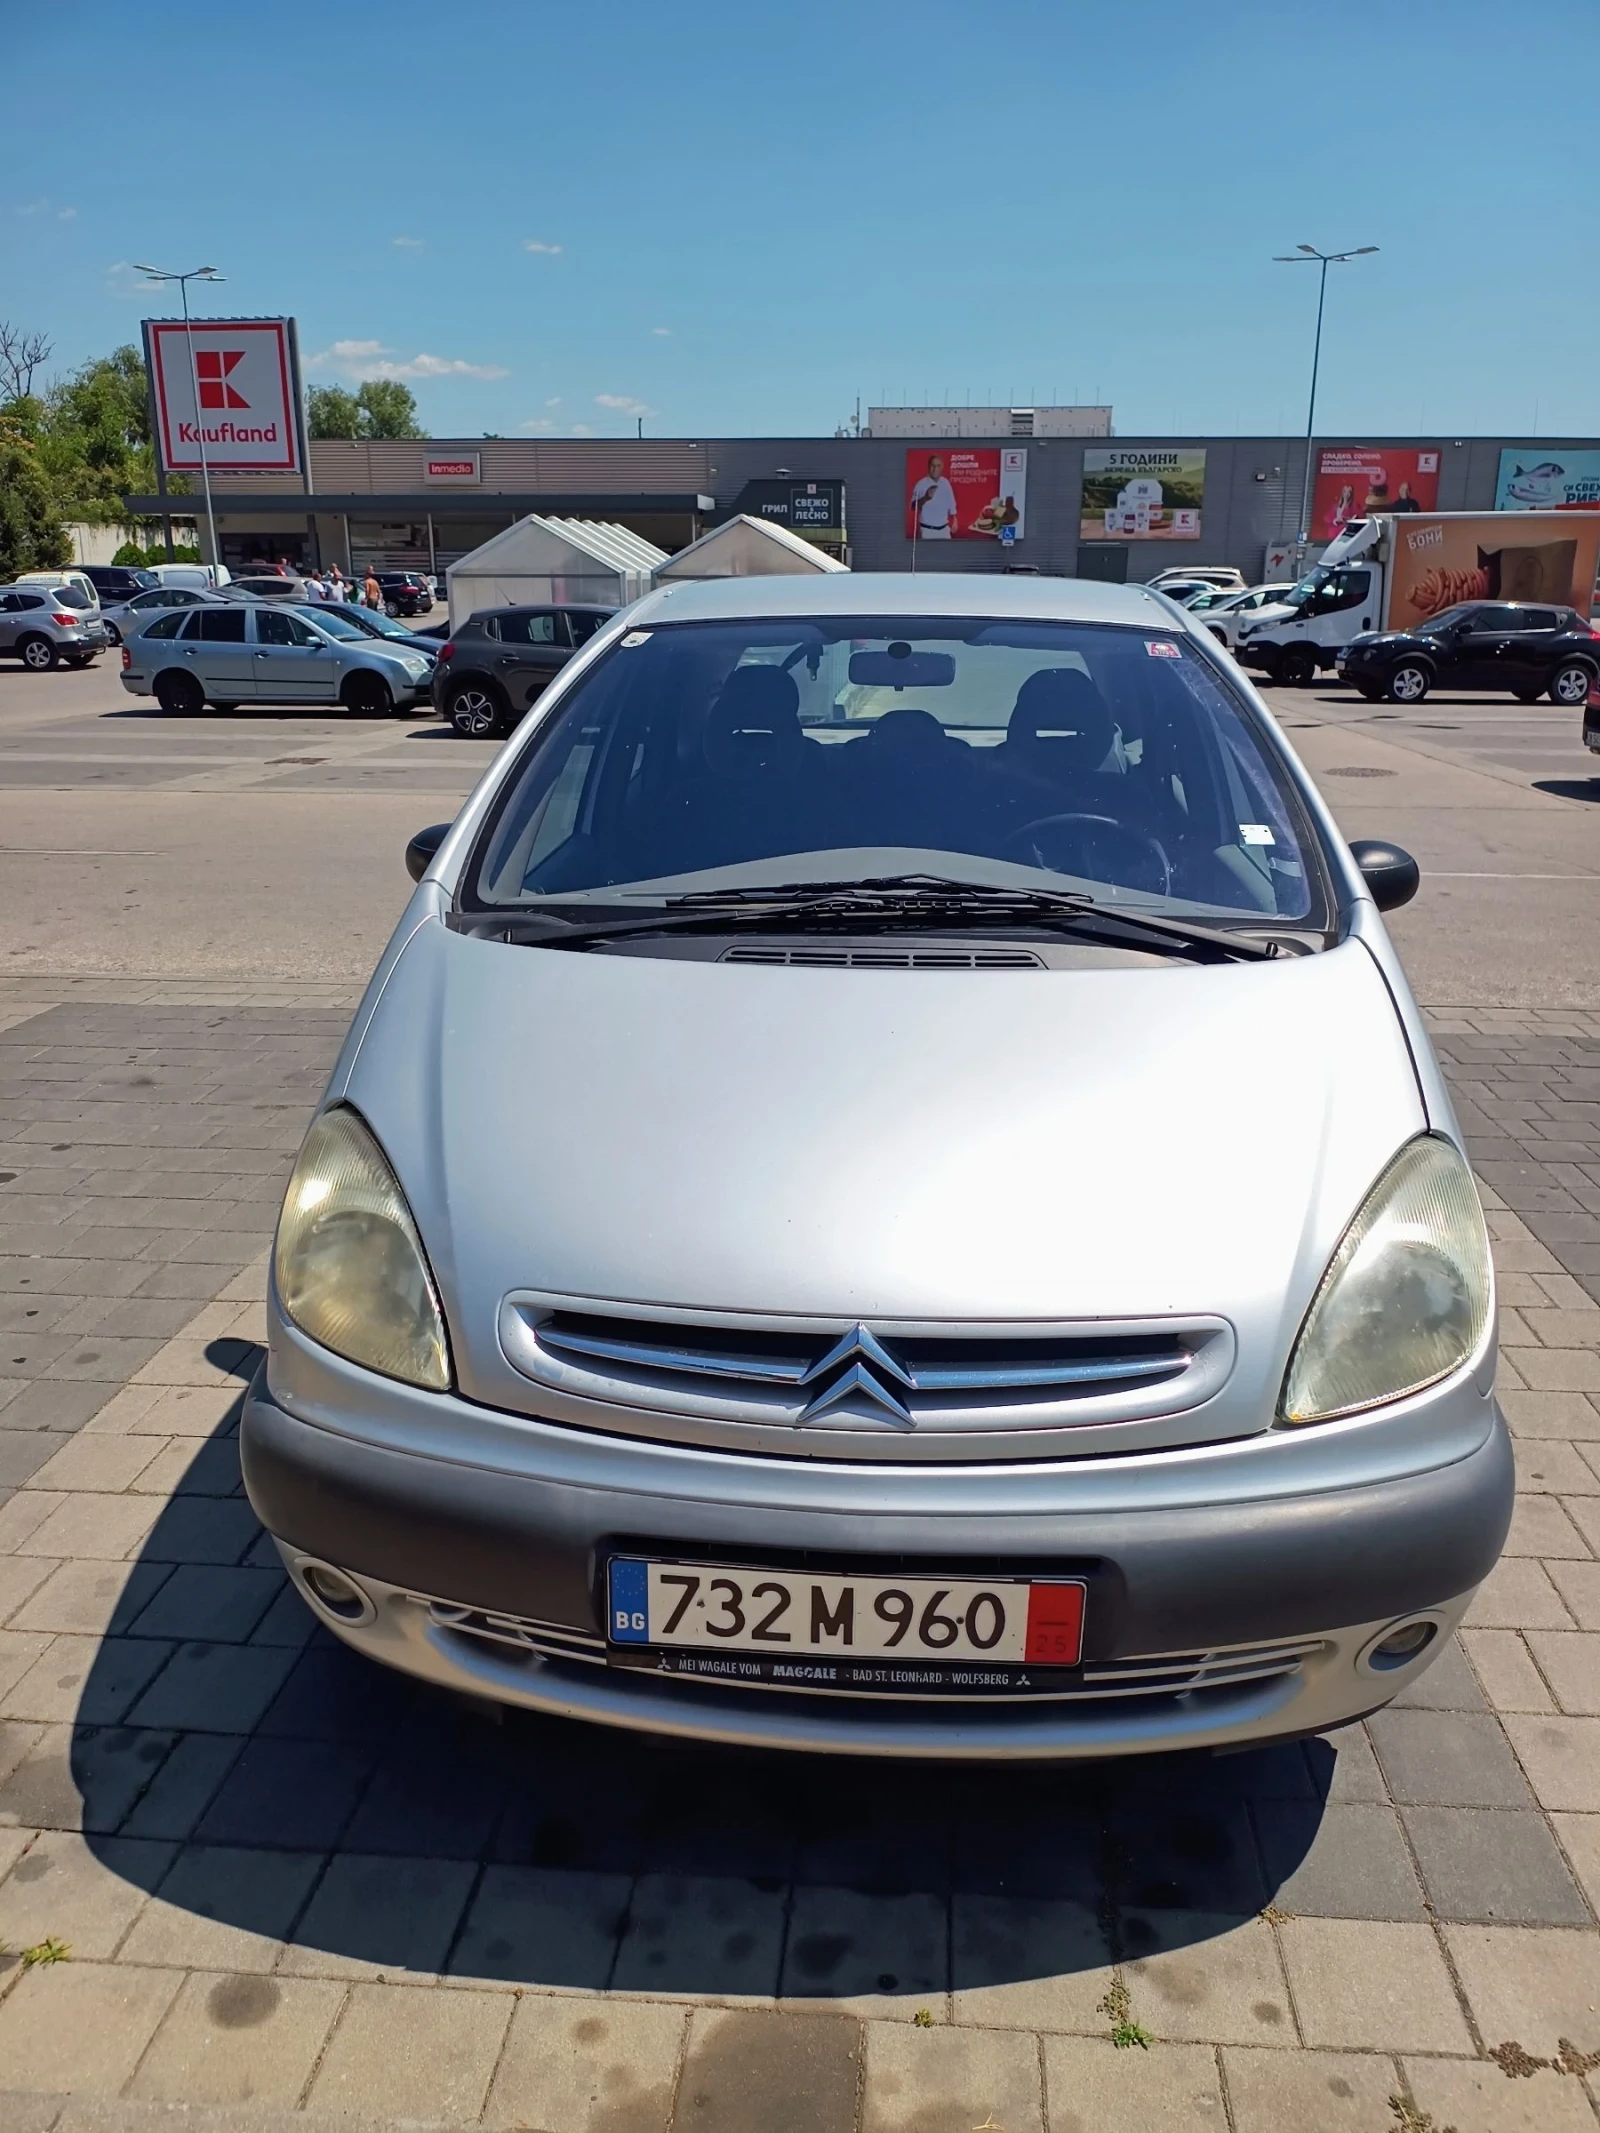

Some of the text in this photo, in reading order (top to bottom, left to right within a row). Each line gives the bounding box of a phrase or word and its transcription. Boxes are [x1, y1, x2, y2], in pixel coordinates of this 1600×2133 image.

[178, 422, 277, 443] Kaufland
[1109, 454, 1178, 466] 5 ГОДИНИ
[795, 499, 829, 507] СВЕЖО
[1565, 493, 1600, 504] РИБ
[762, 504, 788, 513] ГРИЛ
[795, 512, 829, 520] ЛЕСНО
[660, 1574, 1006, 1650] 732 M 960
[615, 1611, 645, 1630] BG
[679, 1659, 695, 1671] MEI
[699, 1660, 737, 1674] WAGALE
[739, 1663, 761, 1676] VOM
[853, 1669, 872, 1681] BAD
[875, 1671, 888, 1682] ST.
[952, 1672, 1009, 1685] WOLFSBERG
